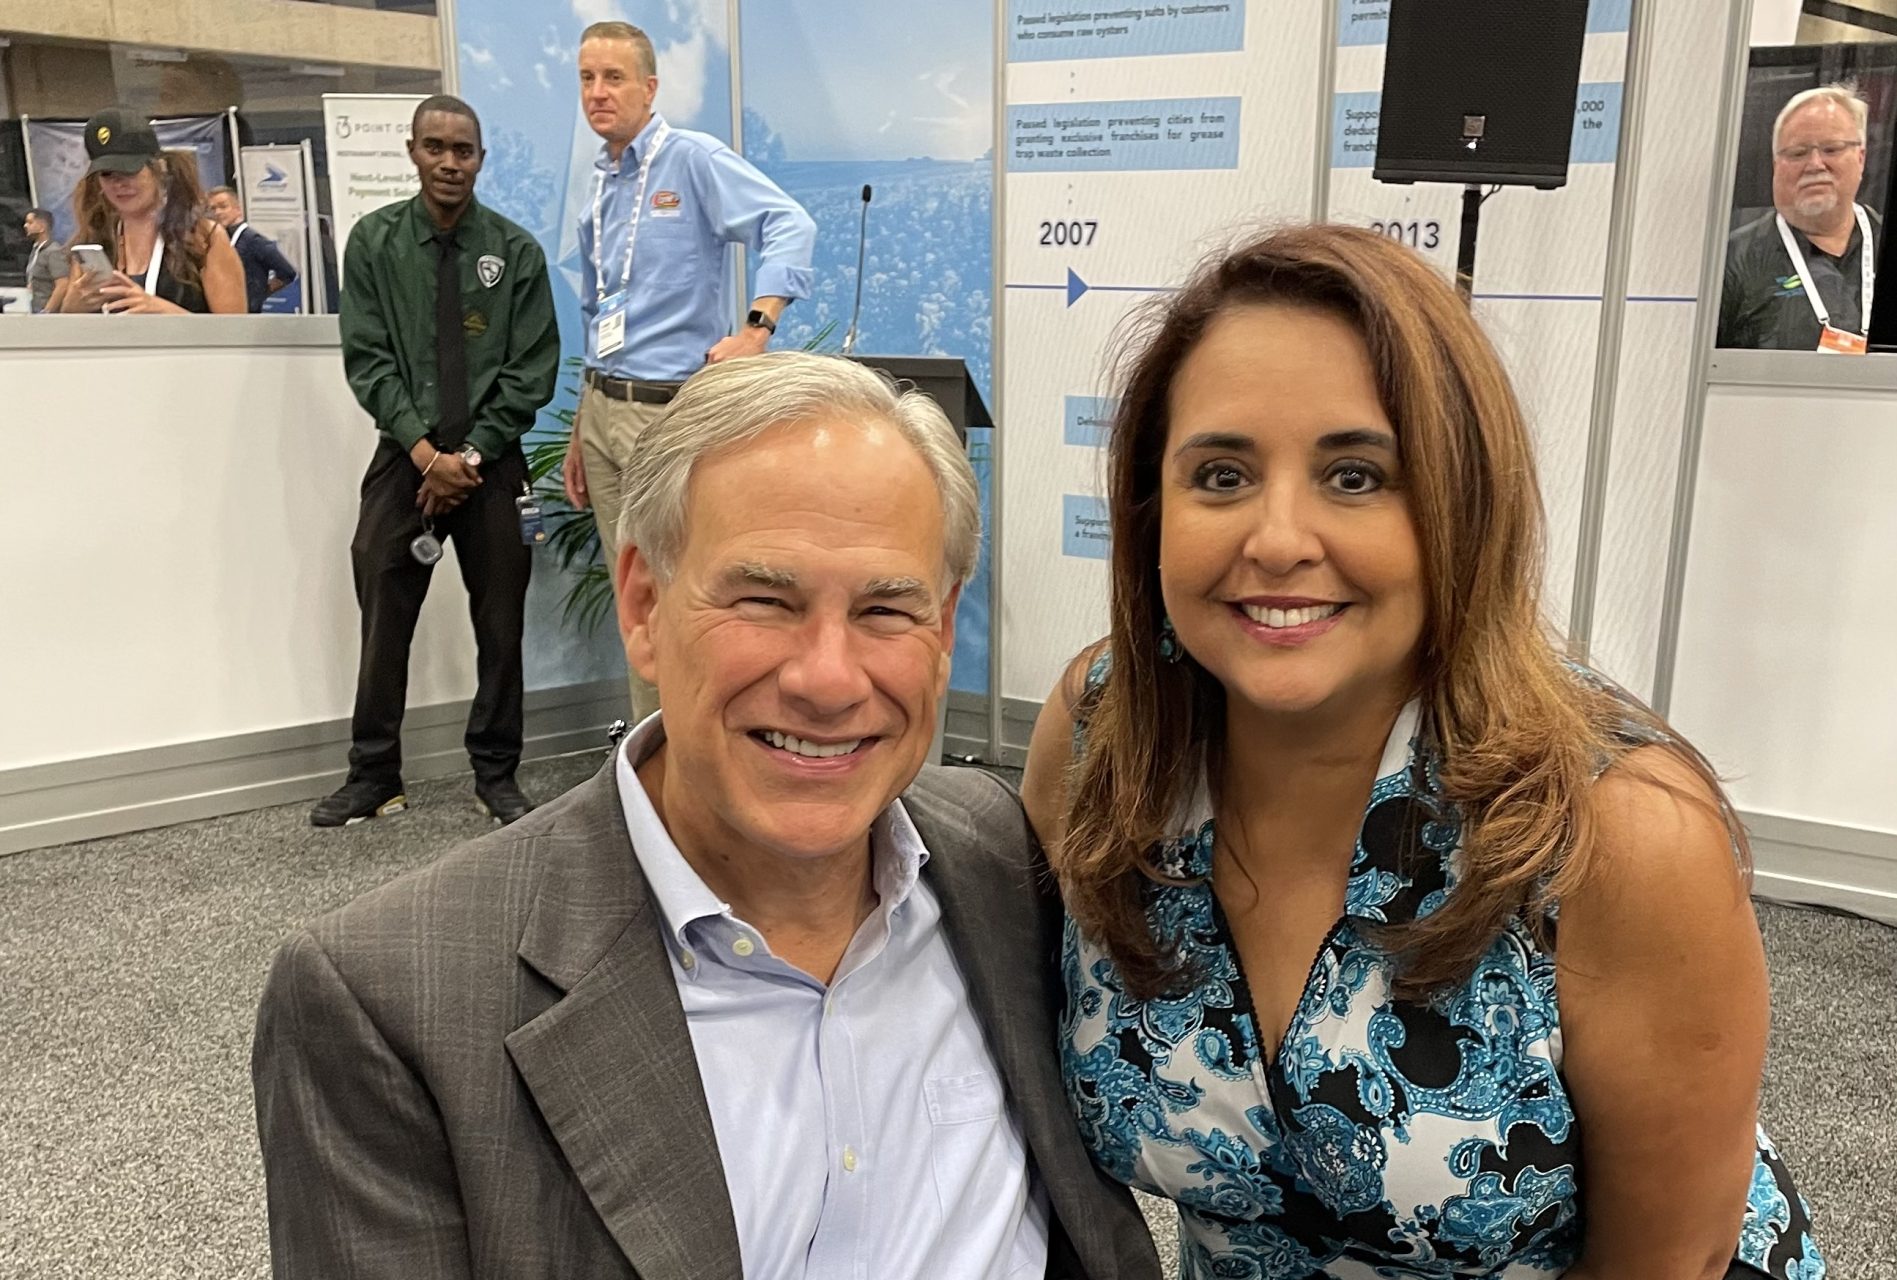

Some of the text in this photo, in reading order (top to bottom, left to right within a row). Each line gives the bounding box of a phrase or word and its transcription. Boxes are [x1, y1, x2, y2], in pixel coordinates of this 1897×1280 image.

[1093, 8, 1142, 23] preventing
[1167, 5, 1179, 18] by
[1181, 4, 1230, 14] customers
[1017, 29, 1035, 39] who
[1107, 115, 1160, 129] preventing
[1167, 114, 1193, 125] cities
[1200, 112, 1225, 123] from
[1583, 117, 1603, 129] the
[1111, 130, 1159, 141] franchises
[1167, 129, 1182, 139] for
[1190, 131, 1224, 142] grease
[1037, 150, 1063, 158] waste
[1066, 147, 1111, 157] collection
[1041, 221, 1098, 246] 2007
